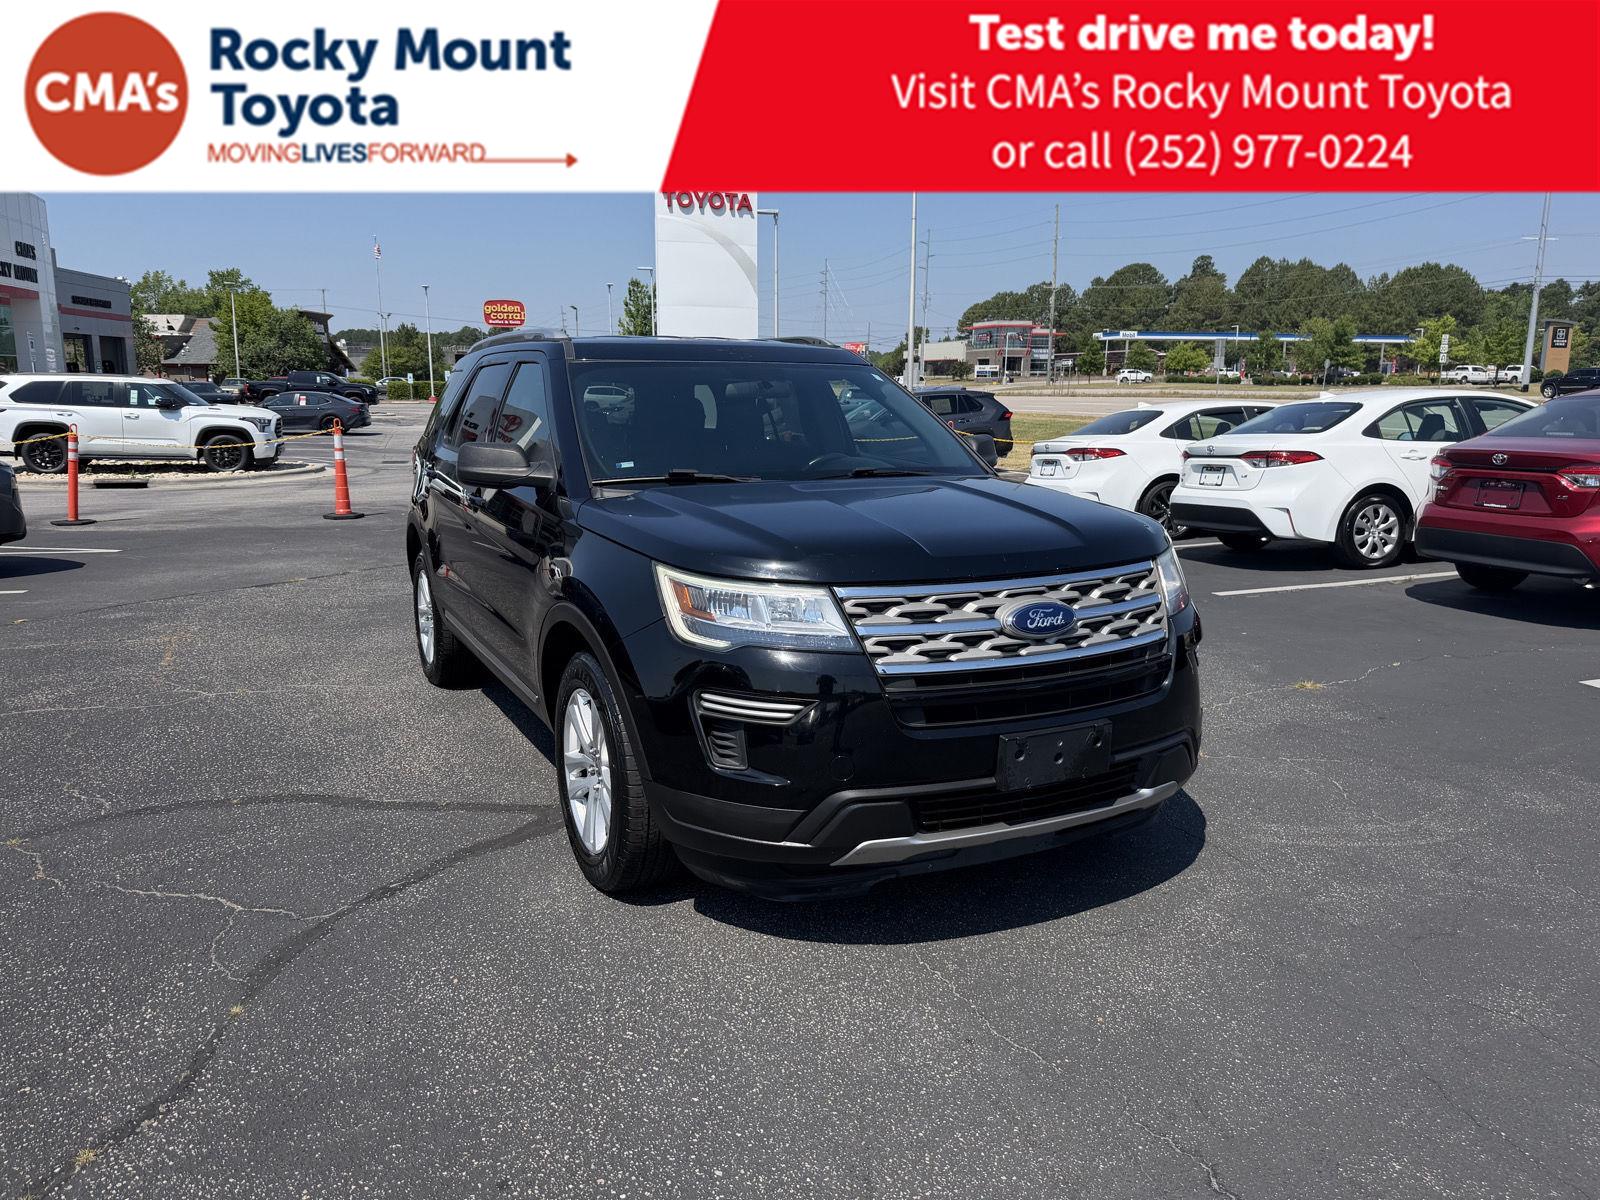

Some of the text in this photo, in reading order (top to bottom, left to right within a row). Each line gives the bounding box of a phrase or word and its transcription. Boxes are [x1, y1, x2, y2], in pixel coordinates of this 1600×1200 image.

[662, 191, 753, 212] TOYOTA
[484, 304, 521, 314] golden
[490, 312, 525, 320] corral
[1027, 608, 1065, 629] Ford
